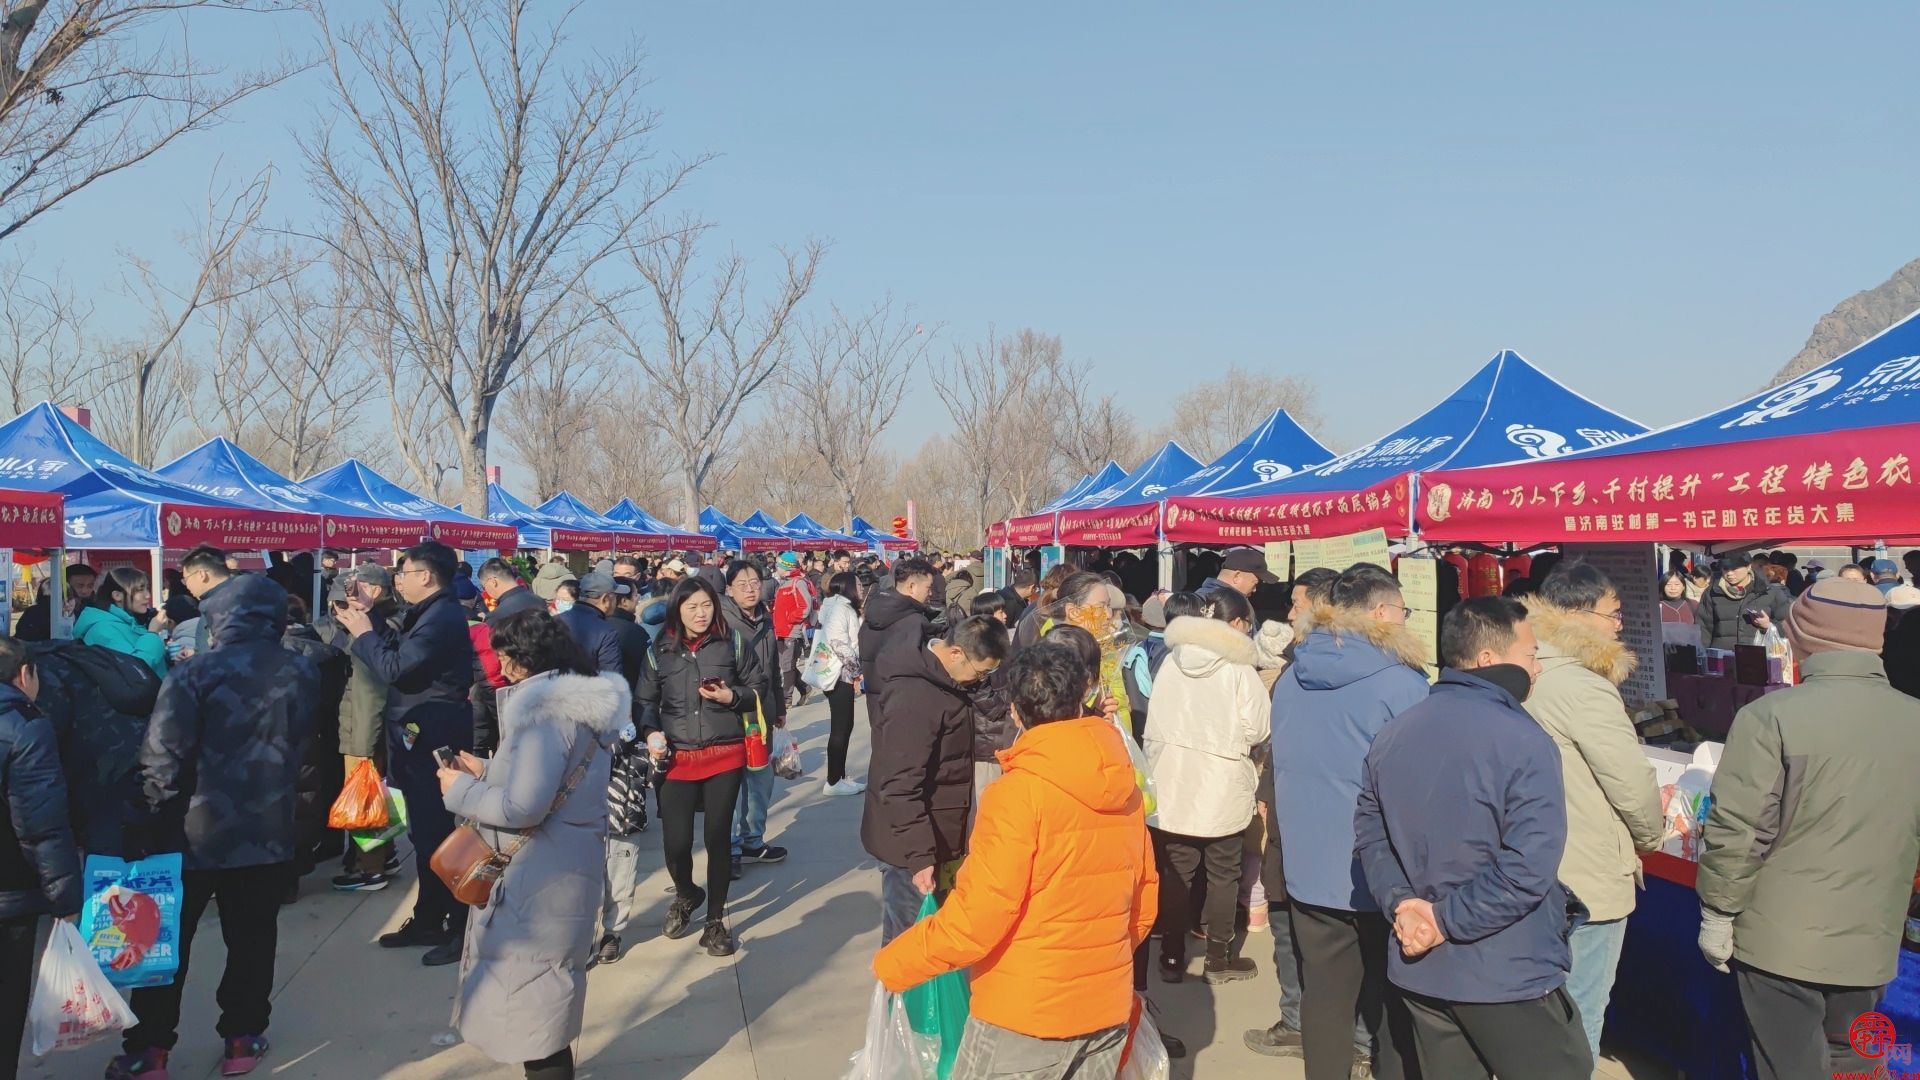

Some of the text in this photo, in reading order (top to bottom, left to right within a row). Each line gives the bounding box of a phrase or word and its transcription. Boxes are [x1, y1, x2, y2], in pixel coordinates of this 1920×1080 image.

[1457, 453, 1920, 510] 济南“万人下乡、千村提升”工程特色农
